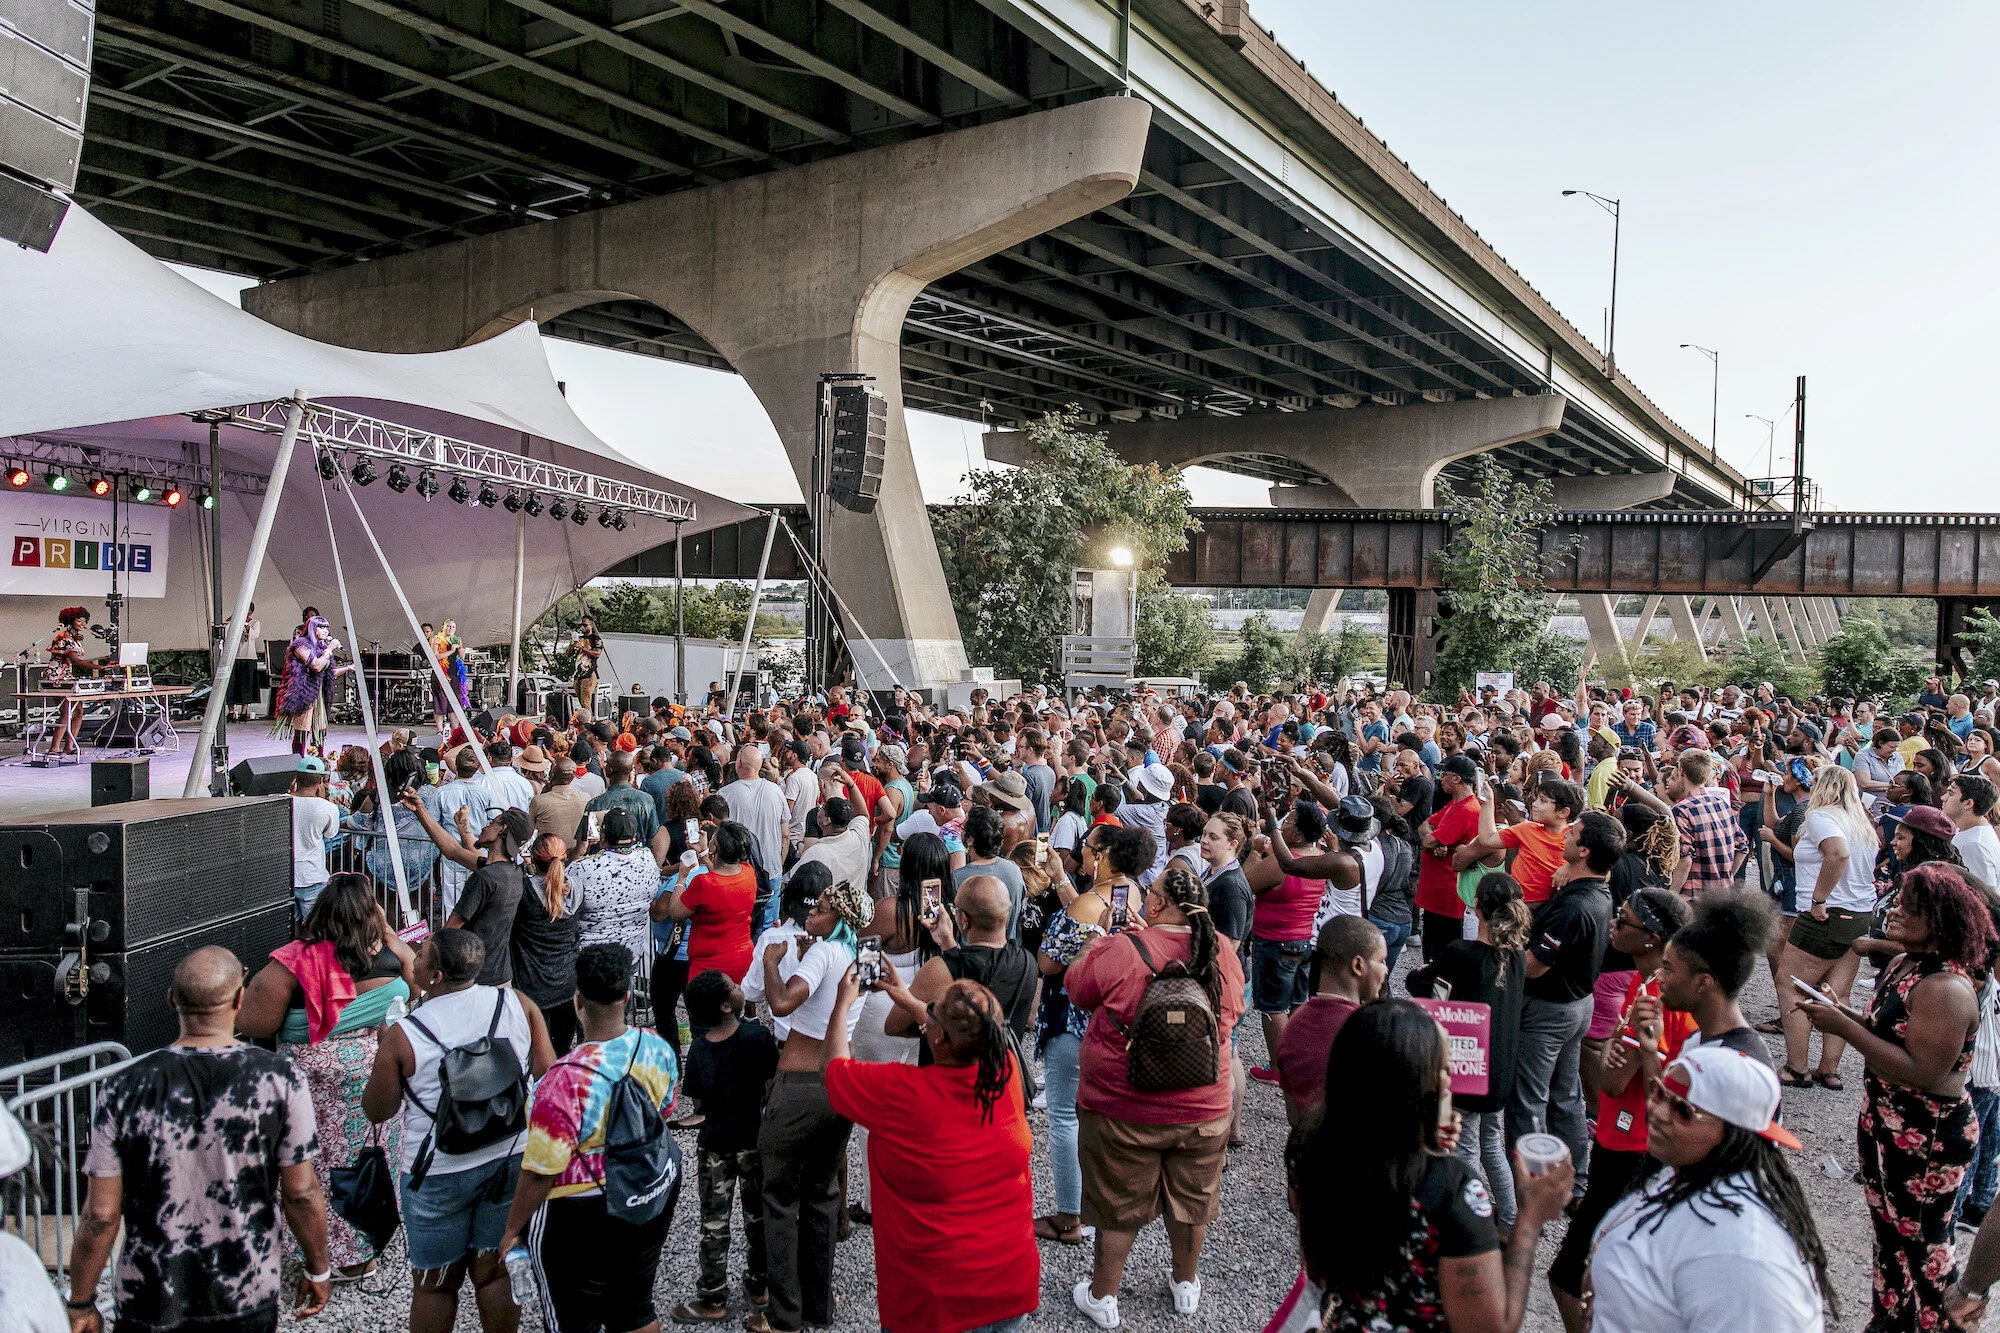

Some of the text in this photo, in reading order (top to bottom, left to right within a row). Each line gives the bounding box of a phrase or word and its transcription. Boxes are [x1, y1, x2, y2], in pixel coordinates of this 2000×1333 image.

[40, 517, 130, 538] VIRGINA
[18, 541, 147, 568] PRIDE
[1448, 1038, 1476, 1050] ITED
[1450, 1061, 1488, 1077] YONE
